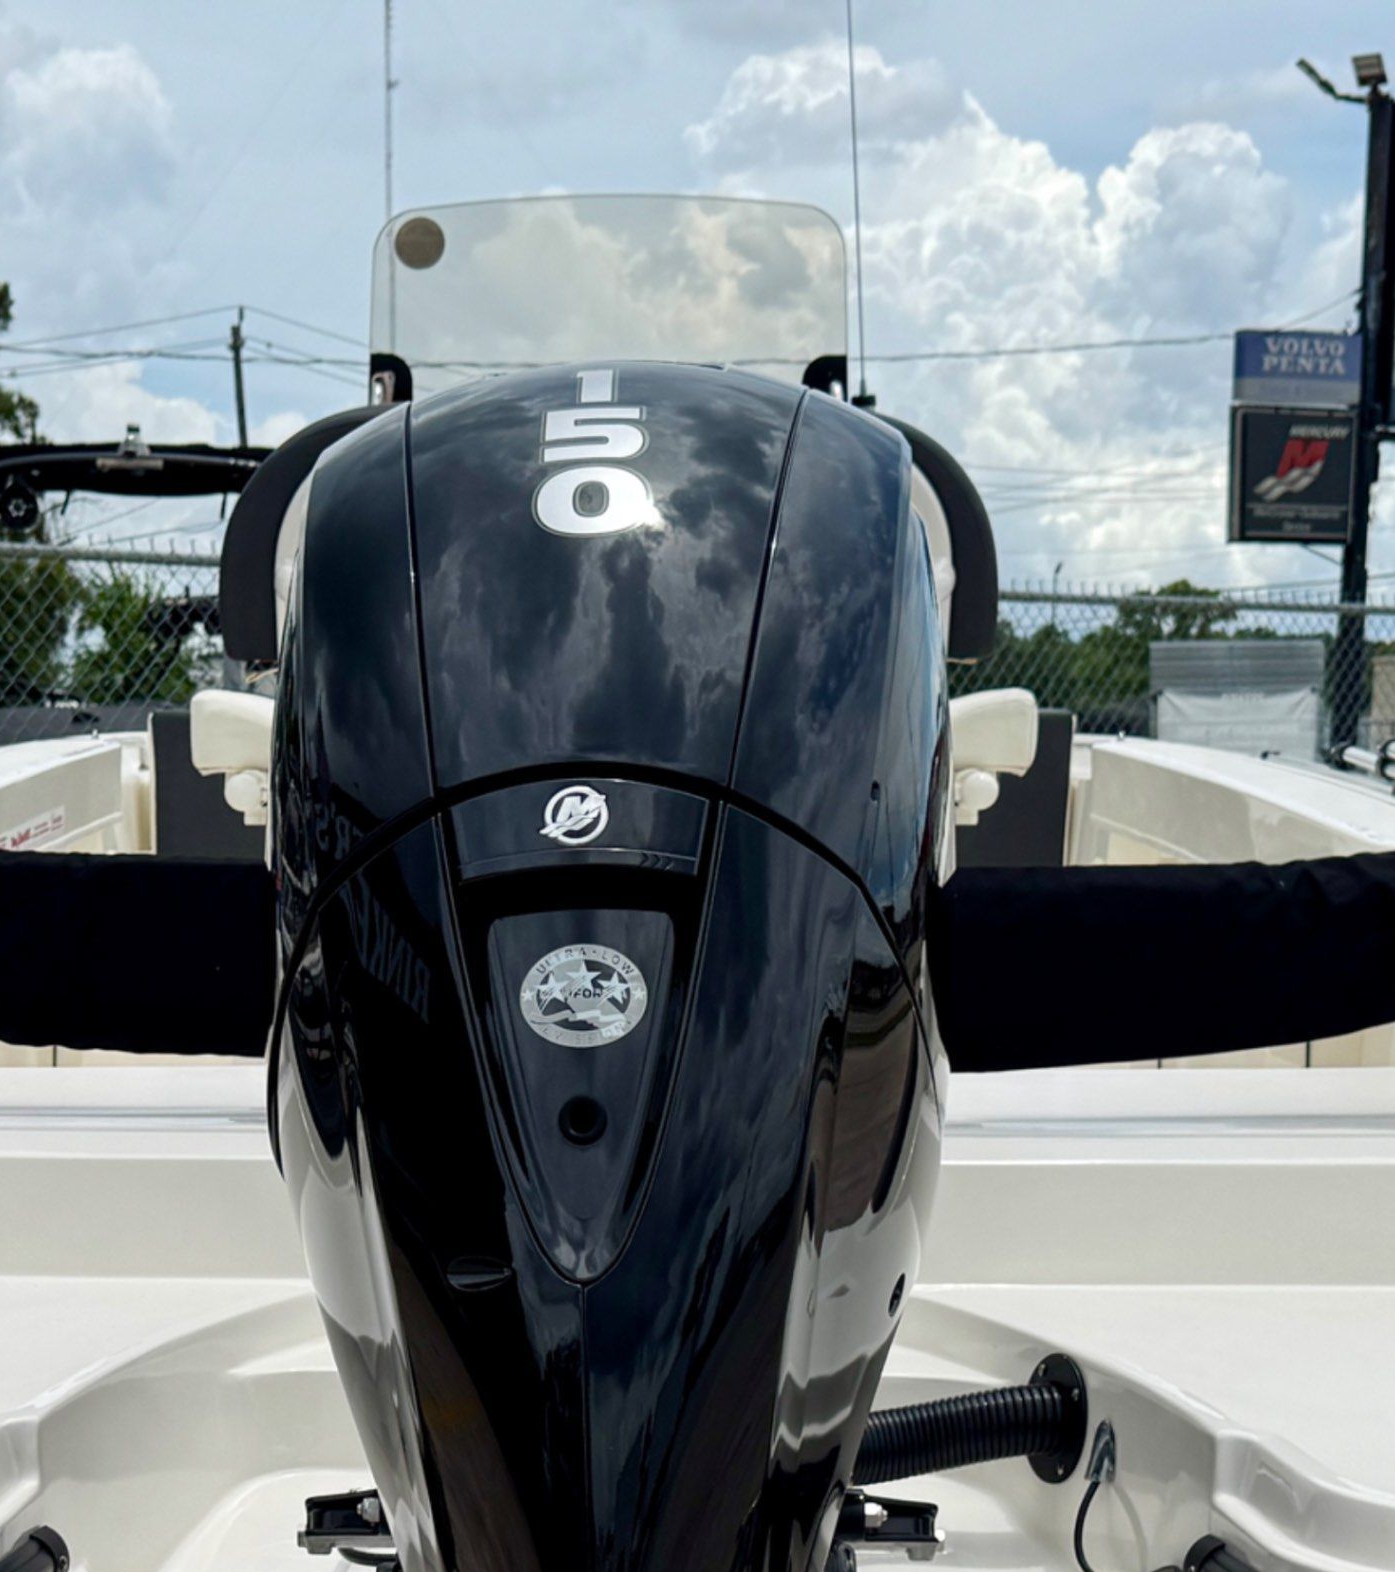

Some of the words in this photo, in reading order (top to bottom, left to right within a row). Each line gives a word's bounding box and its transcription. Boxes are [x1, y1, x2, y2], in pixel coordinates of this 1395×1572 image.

[1265, 337, 1346, 358] VOLVO
[1263, 355, 1346, 375] PENTA
[532, 369, 654, 538] 150
